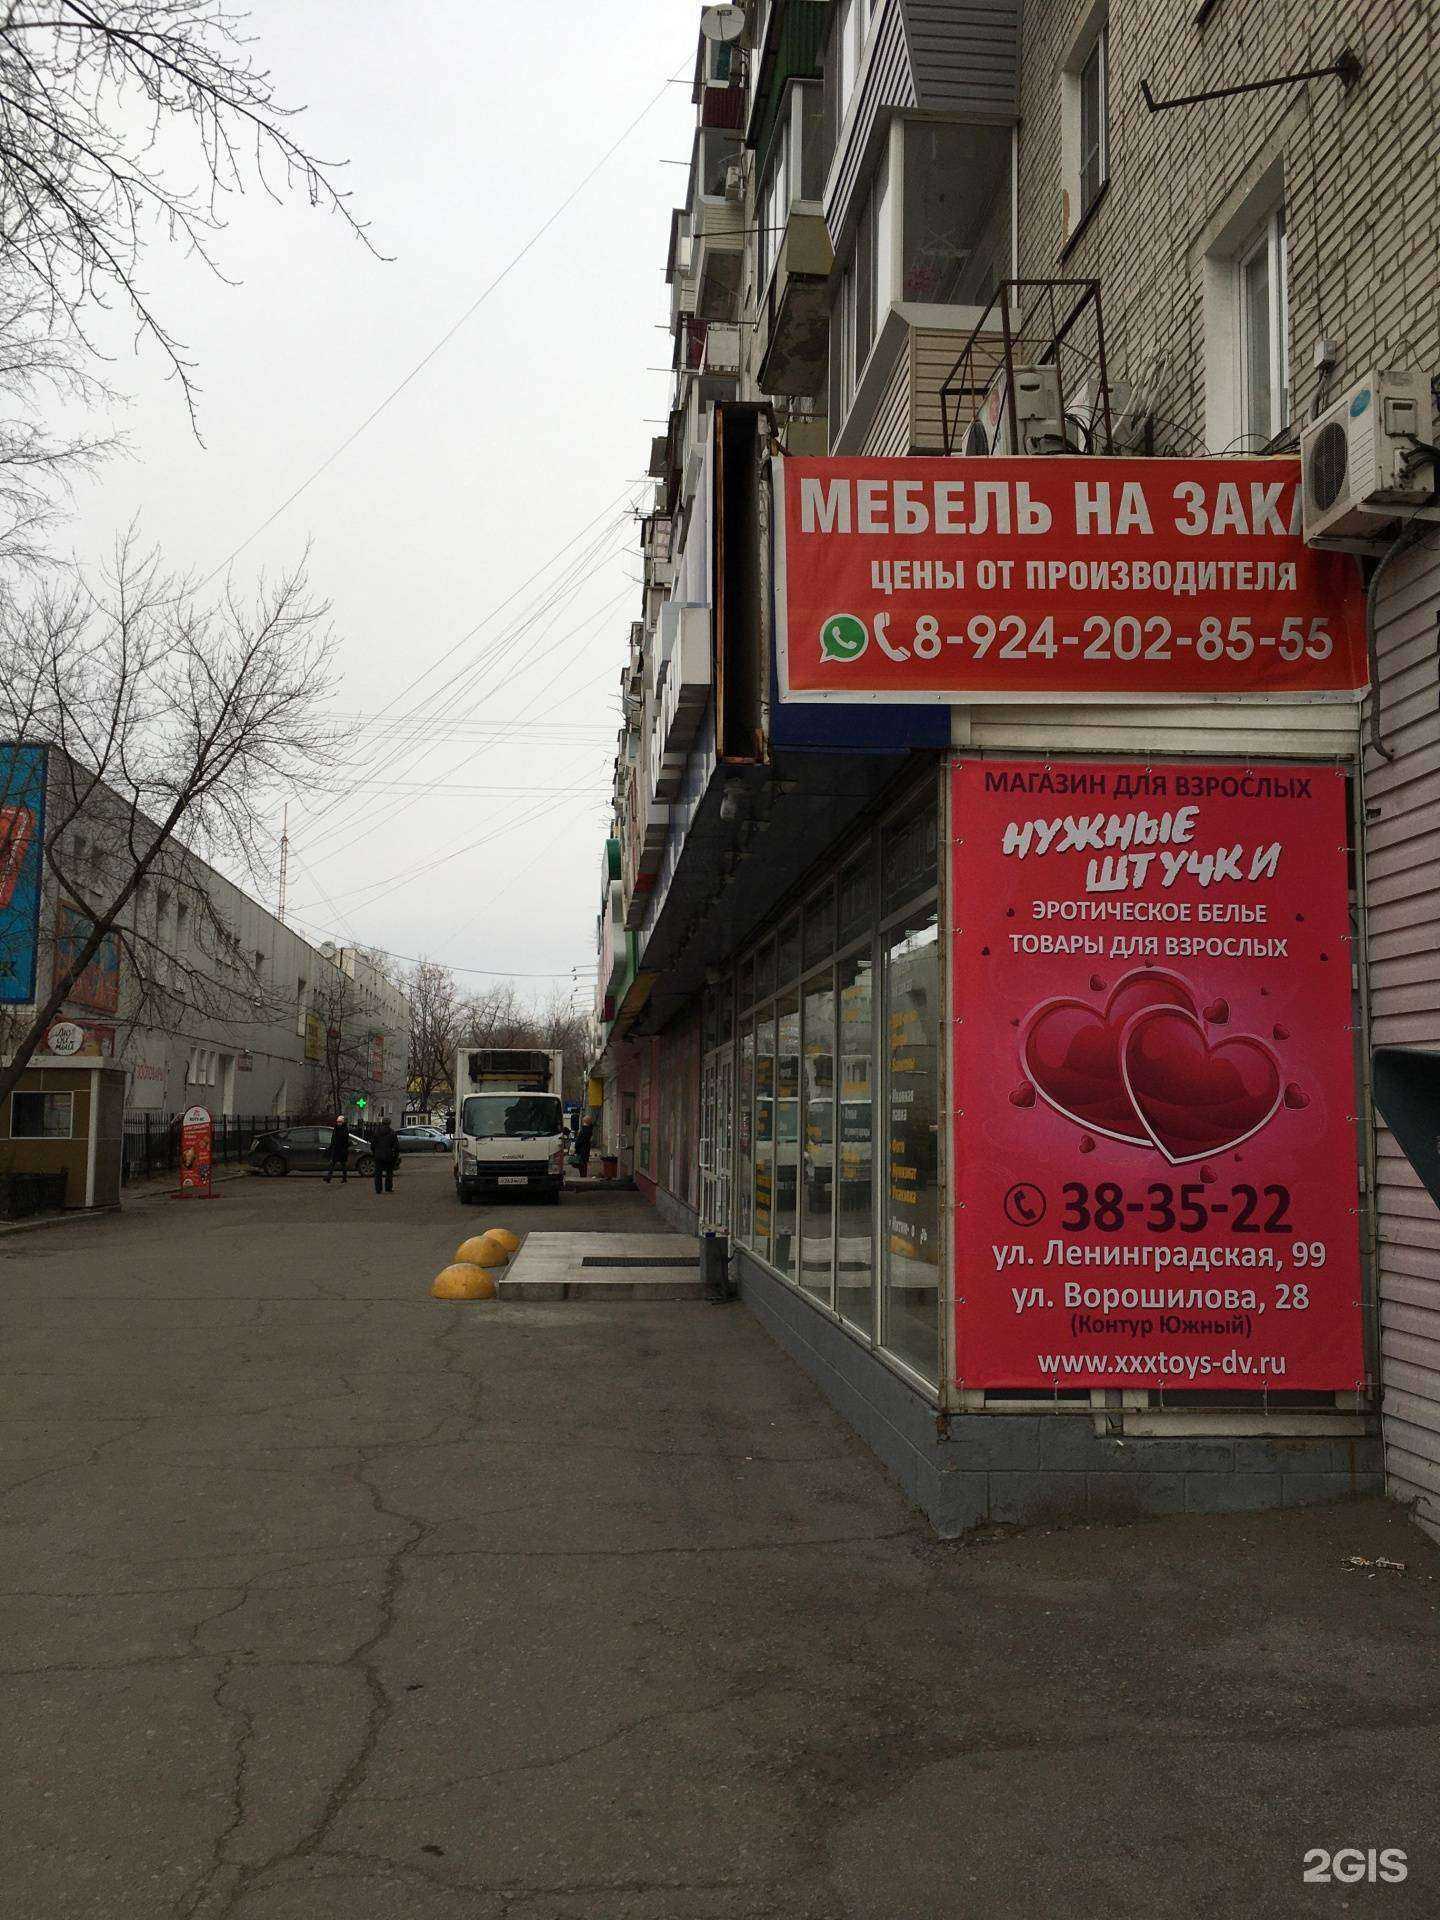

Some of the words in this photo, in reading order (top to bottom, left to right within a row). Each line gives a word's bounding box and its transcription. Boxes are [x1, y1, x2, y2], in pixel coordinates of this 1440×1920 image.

[801, 478, 1052, 534] МЕБЕЛЬ
[1075, 482, 1154, 534] НА
[871, 561, 964, 595] ЦЕНЫ
[977, 560, 1014, 589] ОТ
[1027, 561, 1296, 595] ПРОИЗВОДИТЕЛЯ
[914, 615, 1332, 660] 8-924-202-85-55
[985, 772, 1105, 794] МАГАЗИН
[1114, 773, 1166, 800] ДЛЯ
[1175, 774, 1312, 798] ВЗРОСЛЫХ
[1002, 806, 1199, 858] НУЖНЫЕ
[1086, 842, 1281, 891] ШТУЧКИ
[1033, 901, 1191, 921] ЭРОТИЧЕСКОЕ
[1199, 904, 1266, 922] БЕЛЬЕ
[1009, 934, 1103, 953] ТОВАРЫ
[1110, 936, 1157, 958] ДЛЯ
[1166, 937, 1288, 956] ВЗРОСЛЫХ
[1062, 1182, 1292, 1233] 38-35-22
[992, 1245, 1033, 1270] ул.
[1043, 1240, 1282, 1272] Ленинградская,
[1293, 1242, 1325, 1267] 99
[1012, 1288, 1053, 1313] ул.
[1065, 1282, 1265, 1314] Ворошилова,
[1276, 1284, 1309, 1309] 28
[1071, 1315, 1153, 1338] (Контур
[1160, 1315, 1252, 1338] Южный)
[1038, 1350, 1285, 1378] www.xxxtoys-dv.ru
